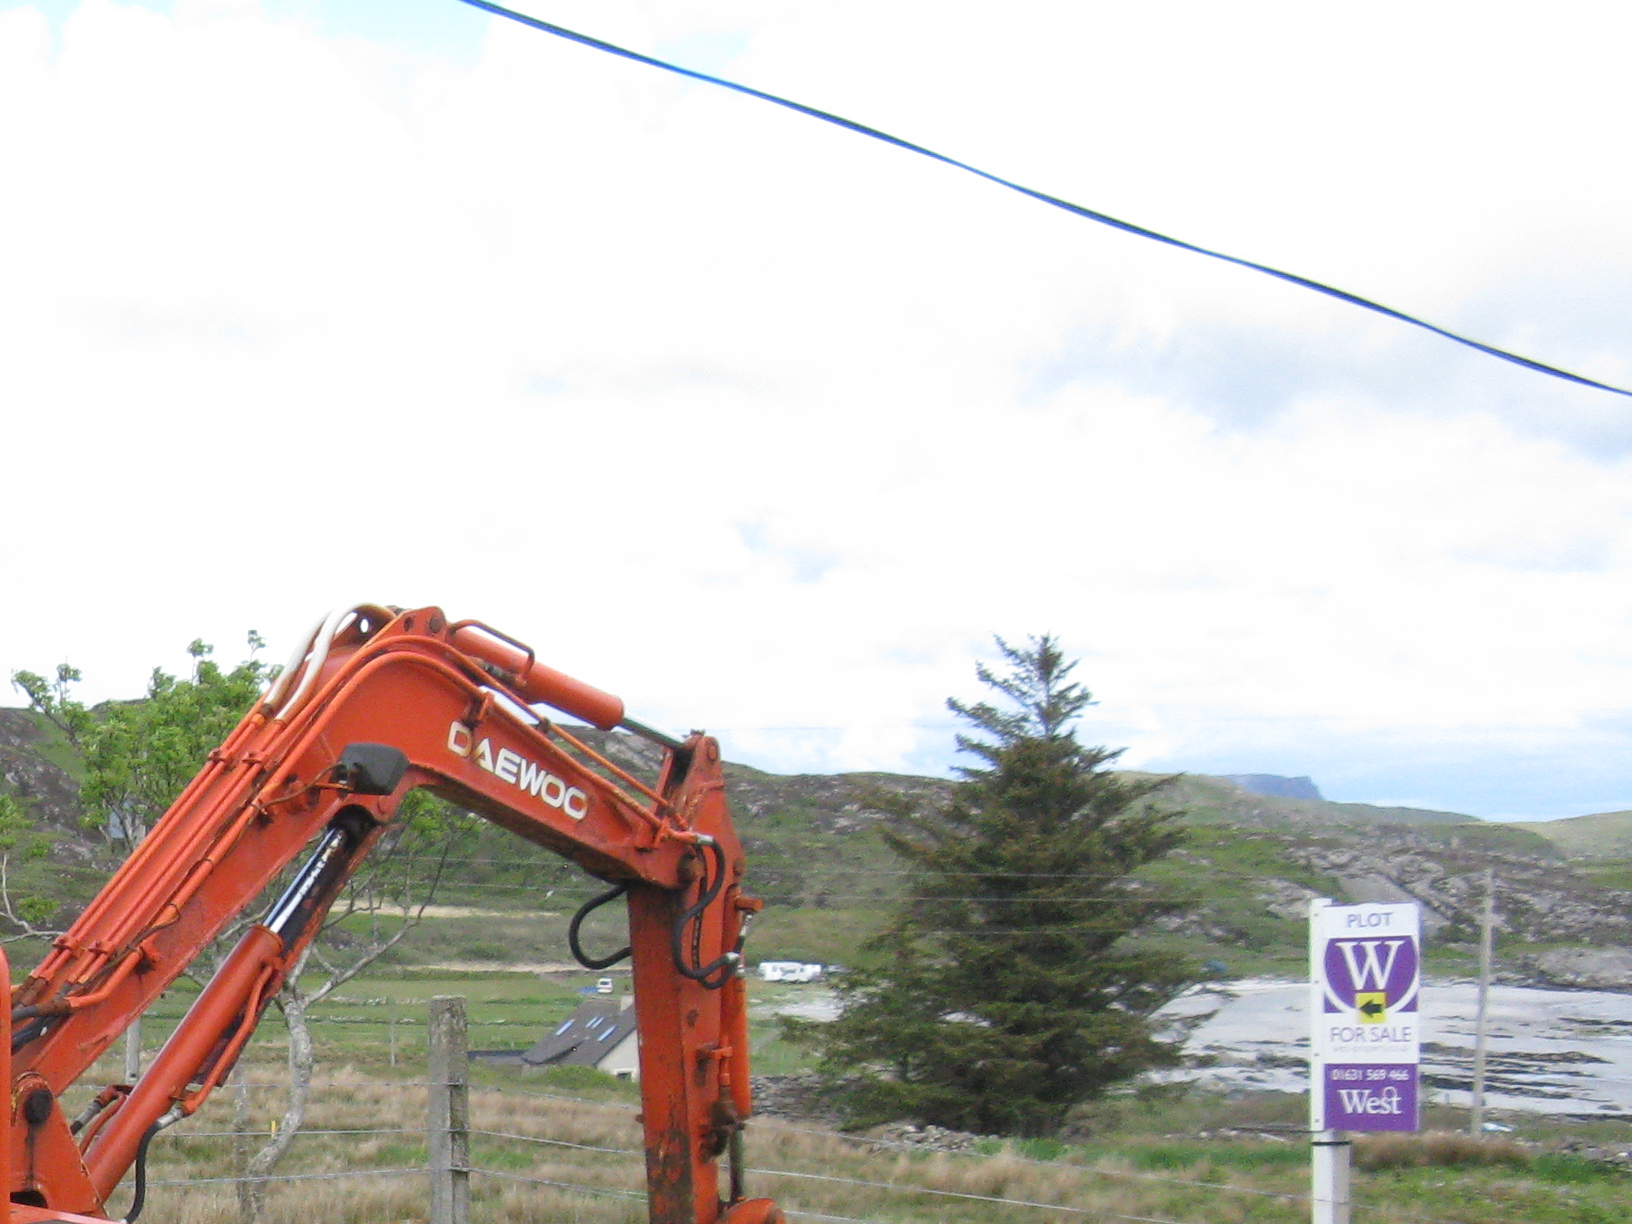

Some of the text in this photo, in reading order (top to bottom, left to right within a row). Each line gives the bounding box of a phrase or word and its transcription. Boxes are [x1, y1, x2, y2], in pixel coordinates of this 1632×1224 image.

[447, 720, 588, 821] DAEWOO
[1346, 912, 1393, 928] PLOT
[1334, 940, 1405, 990] W
[1330, 1026, 1412, 1043] FOR SALE
[1338, 1087, 1402, 1115] West
